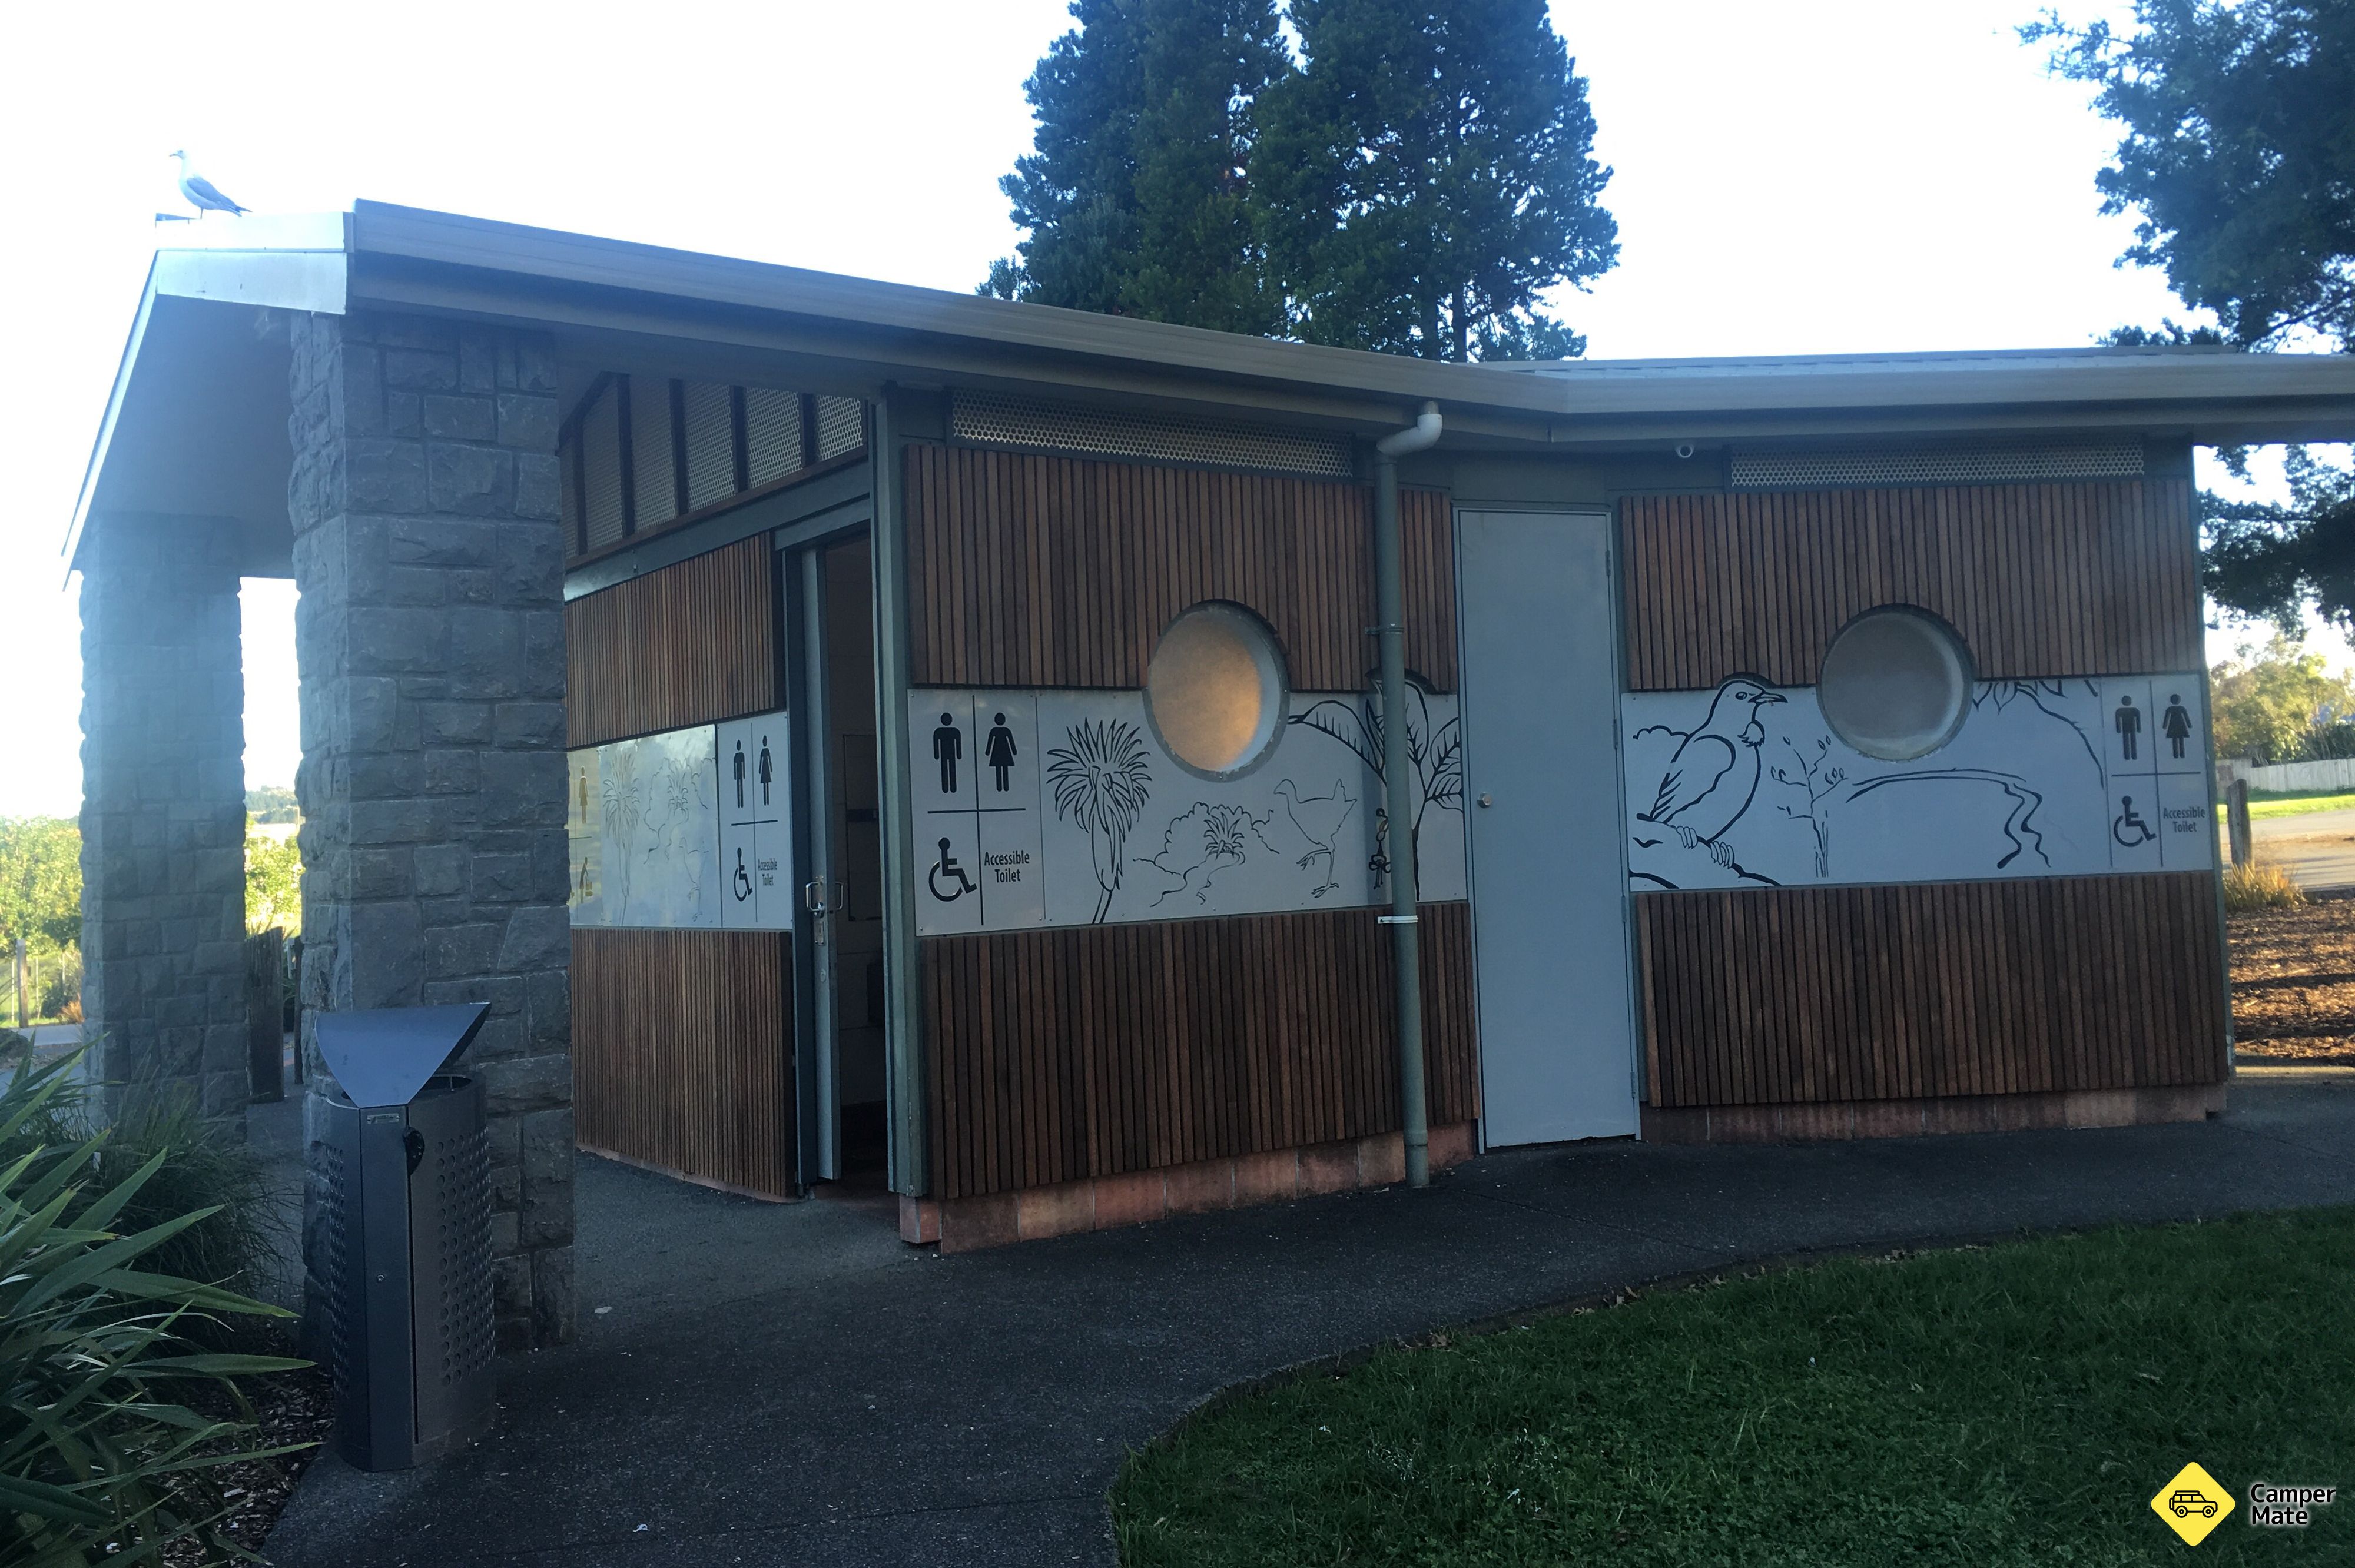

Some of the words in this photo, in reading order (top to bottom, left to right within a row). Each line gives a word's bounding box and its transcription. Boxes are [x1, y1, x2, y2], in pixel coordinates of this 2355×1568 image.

[2163, 806, 2205, 819] Accessible
[2172, 821, 2197, 833] Toilet
[984, 849, 1030, 866] Accessible
[994, 868, 1021, 883] Toilet
